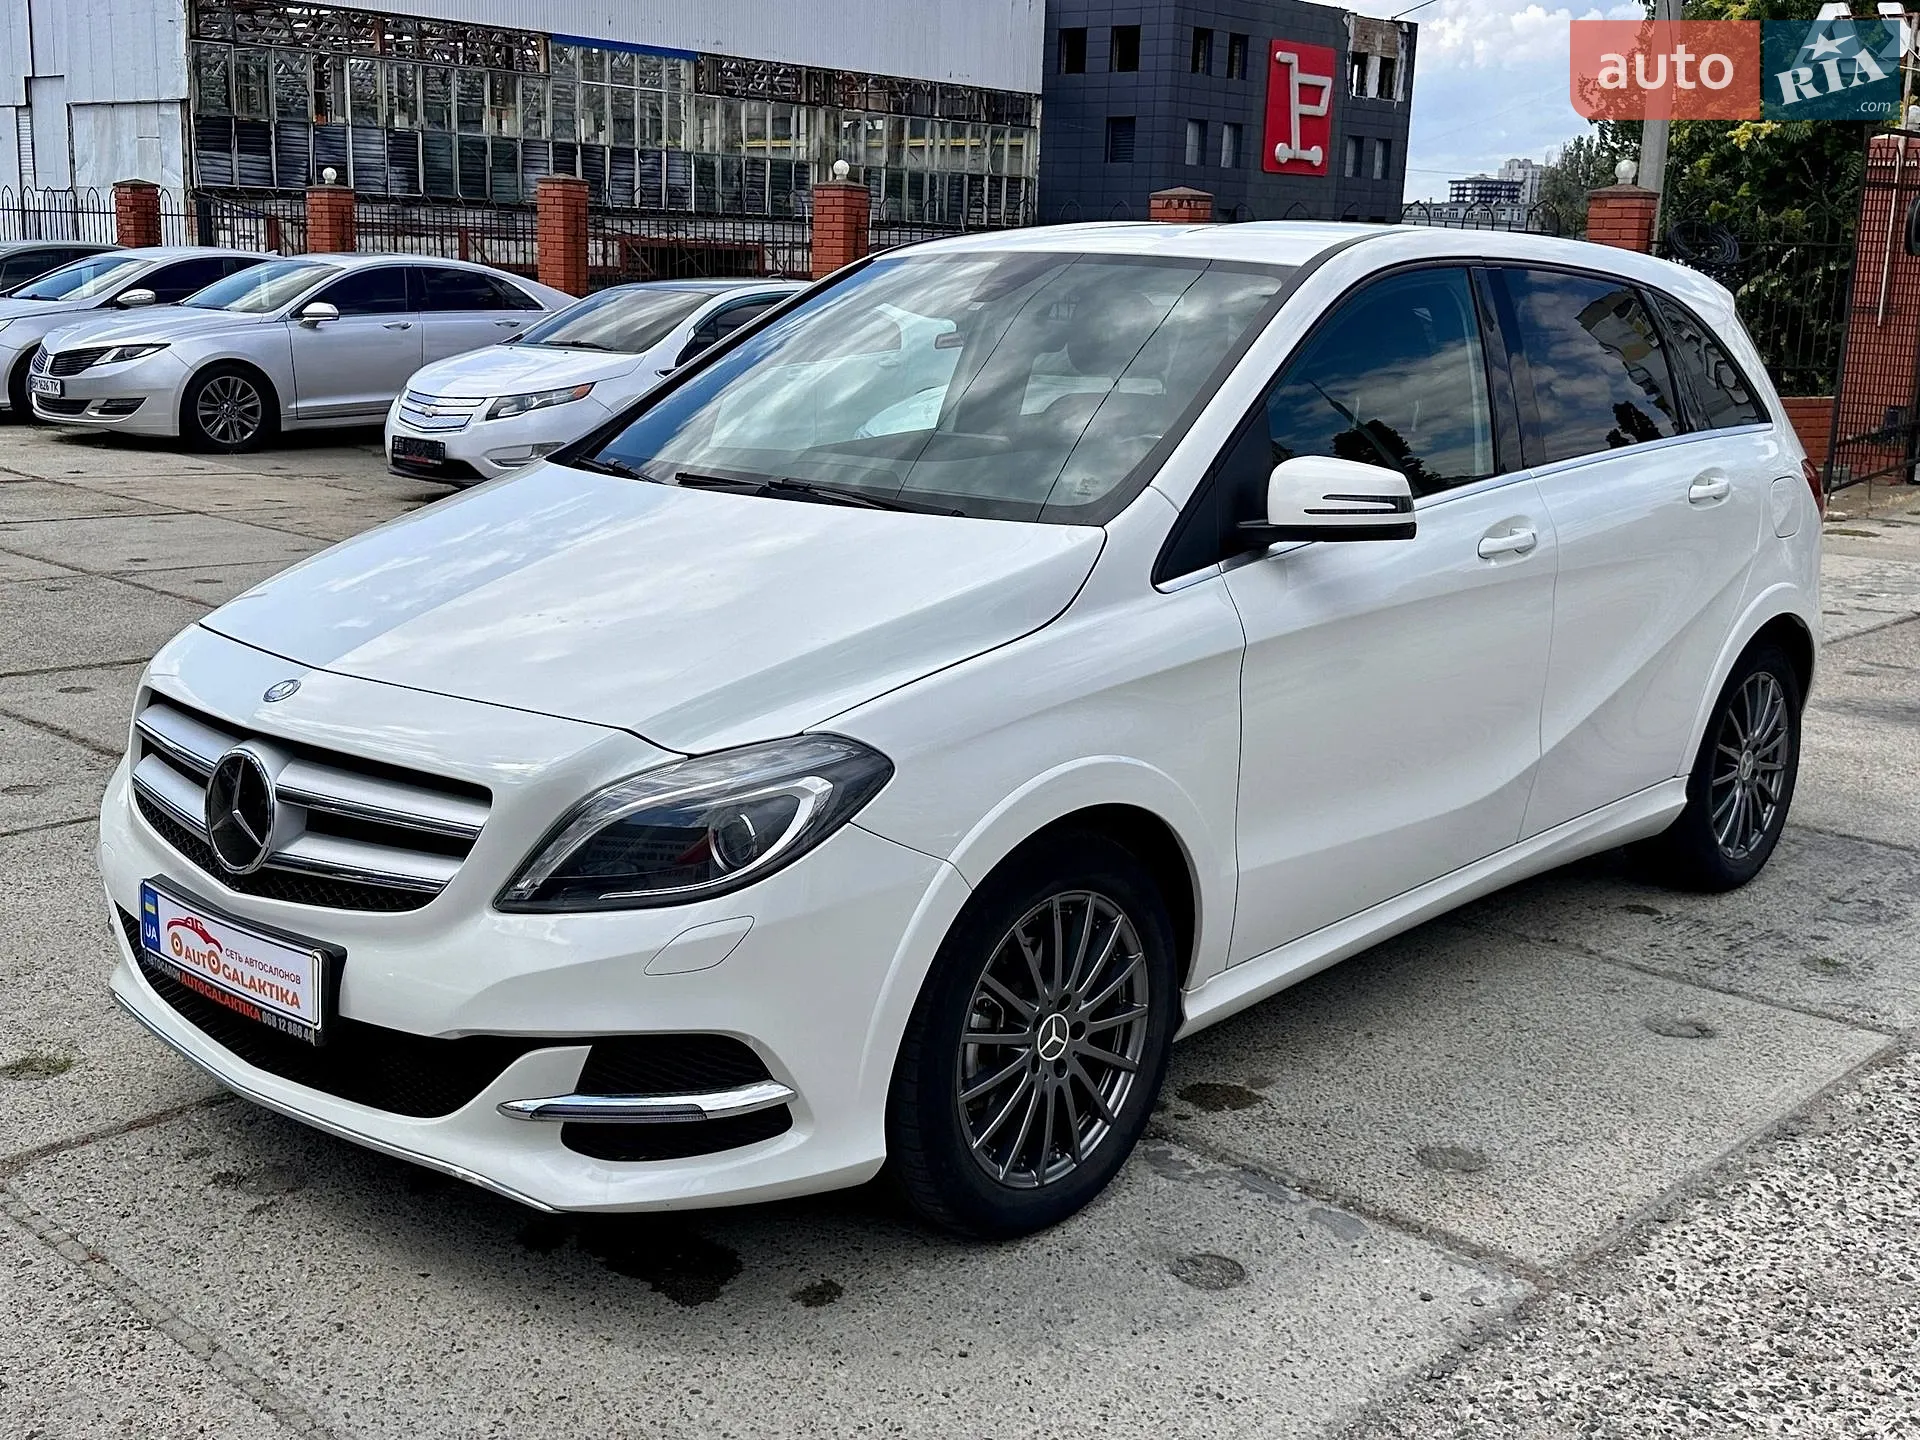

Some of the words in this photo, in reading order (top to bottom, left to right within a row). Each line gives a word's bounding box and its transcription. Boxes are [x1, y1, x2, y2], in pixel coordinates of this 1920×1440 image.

[145, 921, 158, 942] UA
[225, 948, 243, 963] СЕТЬ
[244, 956, 301, 985] АВТОСАЛОНОВ
[180, 971, 262, 1022] AUTOGALAKTIKA
[278, 1017, 287, 1032] 12
